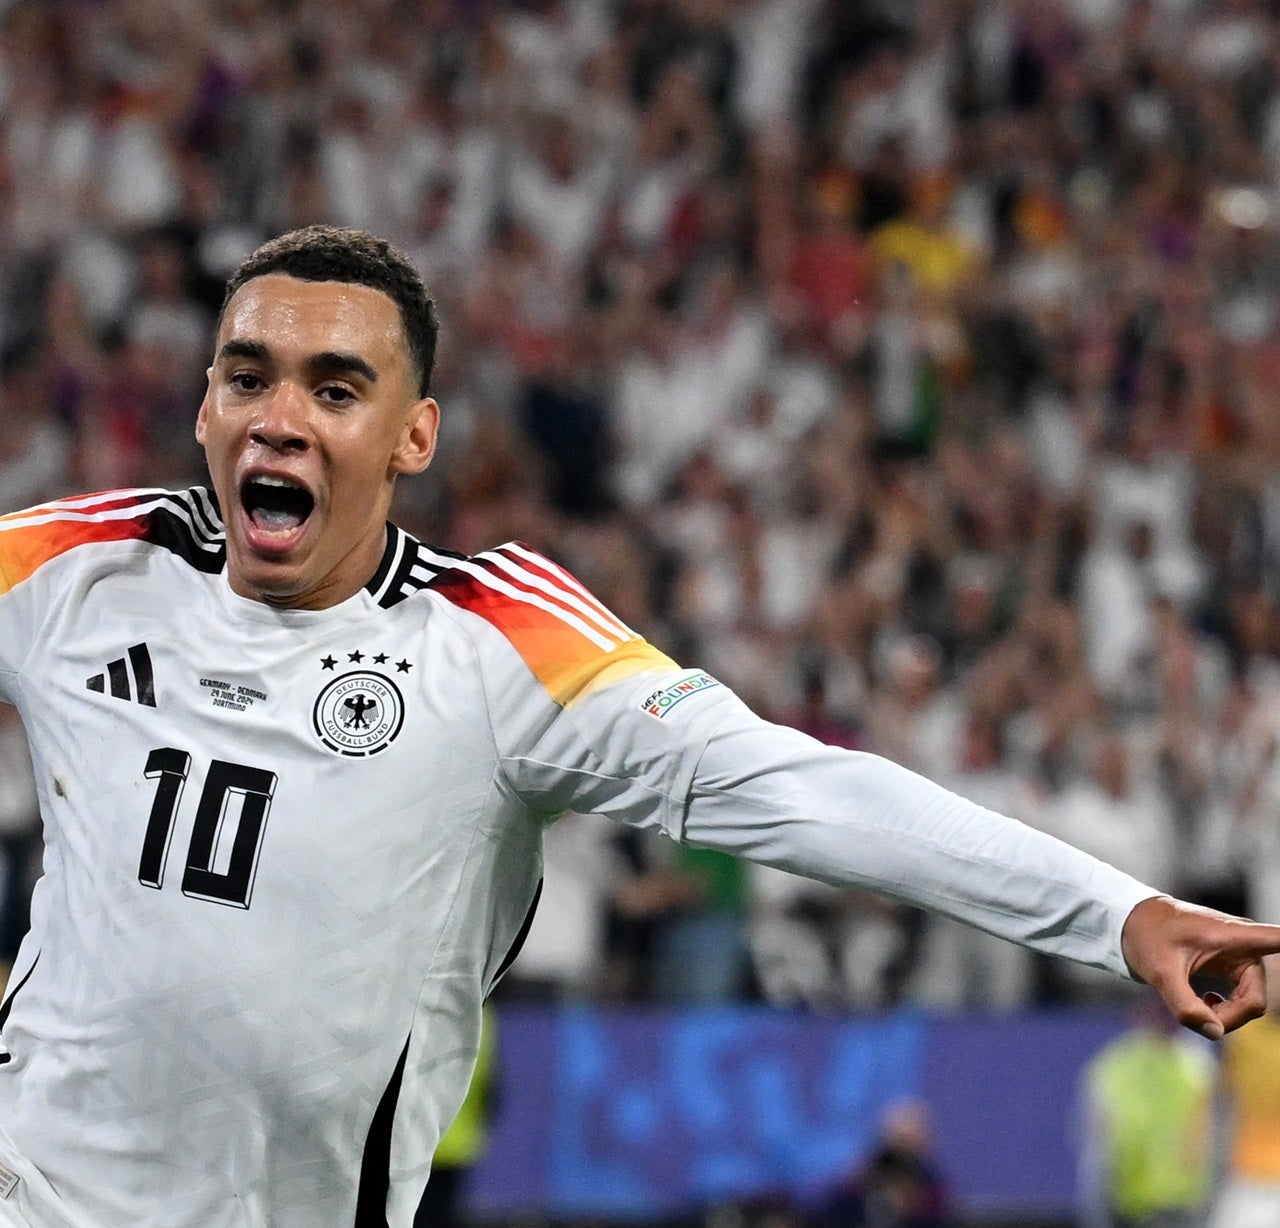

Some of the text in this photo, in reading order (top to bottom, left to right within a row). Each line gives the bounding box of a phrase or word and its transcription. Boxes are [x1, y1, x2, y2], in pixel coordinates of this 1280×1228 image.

[199, 678, 232, 691] GERMANY
[237, 686, 268, 702] DENMARK
[210, 688, 254, 706] 29 JUNE 2024
[336, 680, 388, 698] DEUTSCHER
[212, 698, 247, 712] DORTMUND
[641, 690, 665, 710] UEFA
[325, 719, 390, 746] FUSSBALL-BUND
[138, 747, 279, 911] 10
